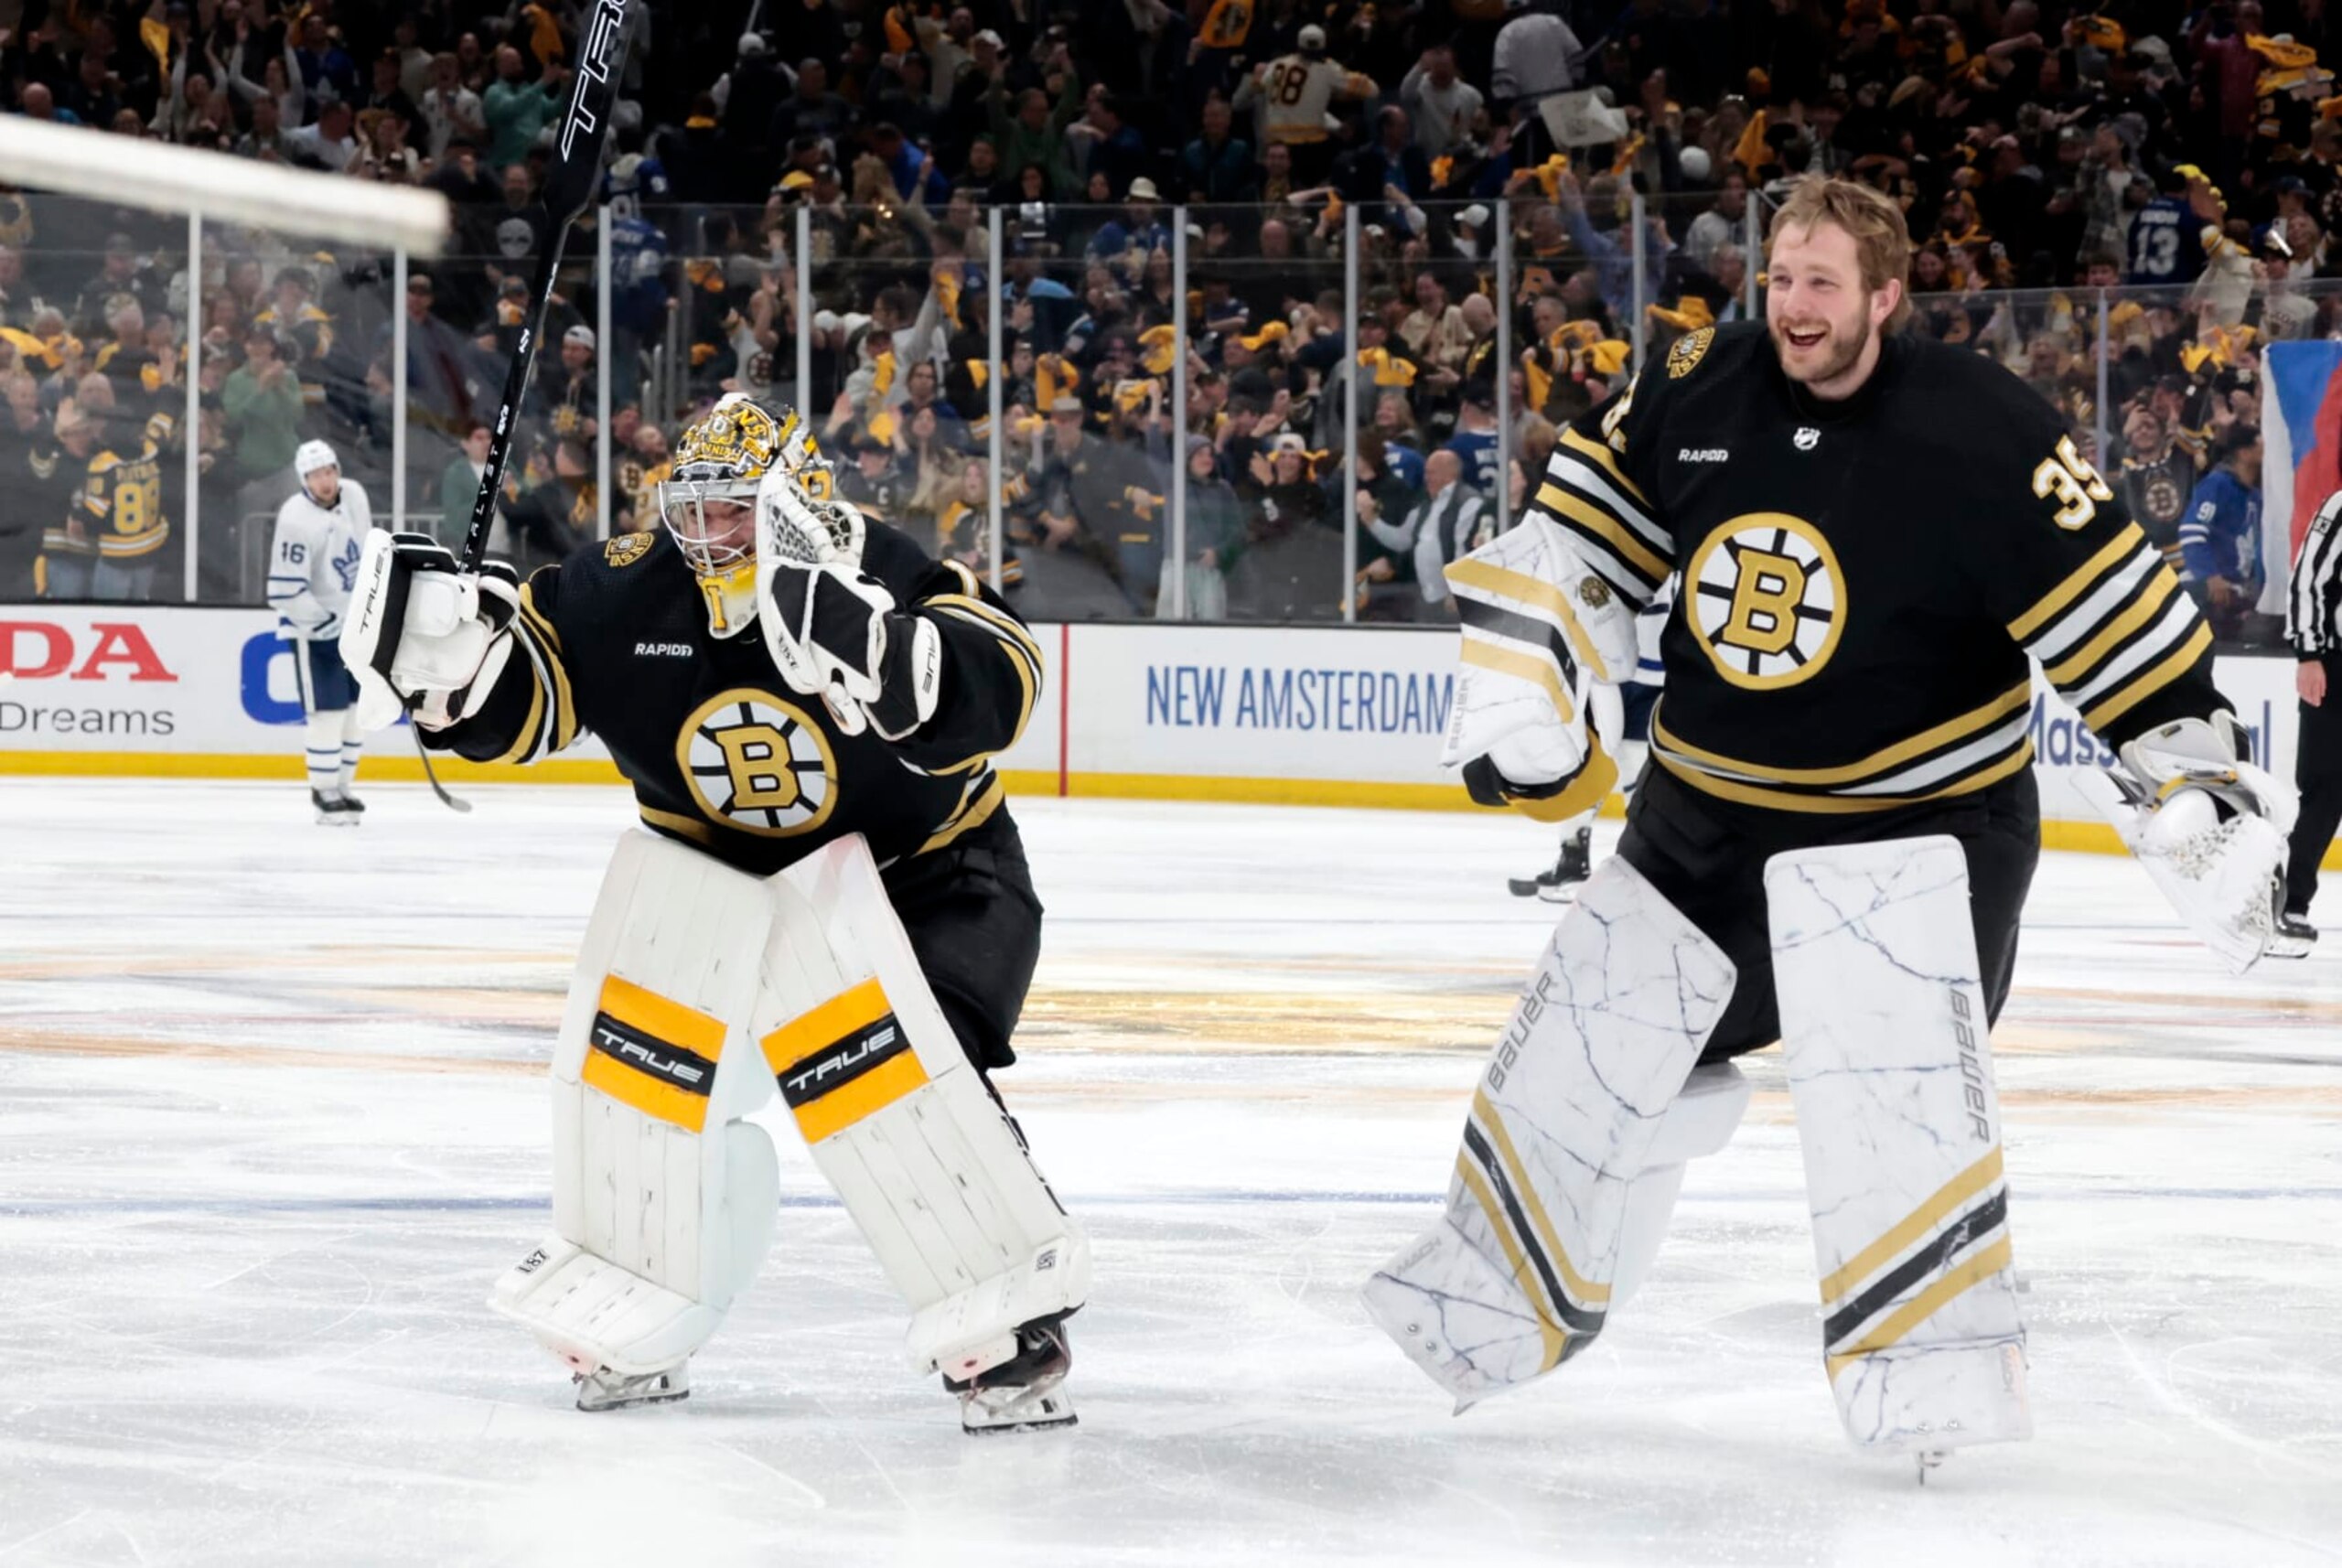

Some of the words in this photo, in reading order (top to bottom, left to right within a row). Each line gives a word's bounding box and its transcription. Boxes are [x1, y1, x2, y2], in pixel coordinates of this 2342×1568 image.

[2133, 226, 2179, 275] 13
[2032, 434, 2114, 531] 35
[282, 542, 306, 564] 16
[0, 702, 175, 736] Dreams
[1147, 665, 1226, 727] NEW
[1235, 668, 1454, 735] AMSTERDAM
[596, 1027, 704, 1084] TRUE
[787, 1026, 896, 1091] TRUE
